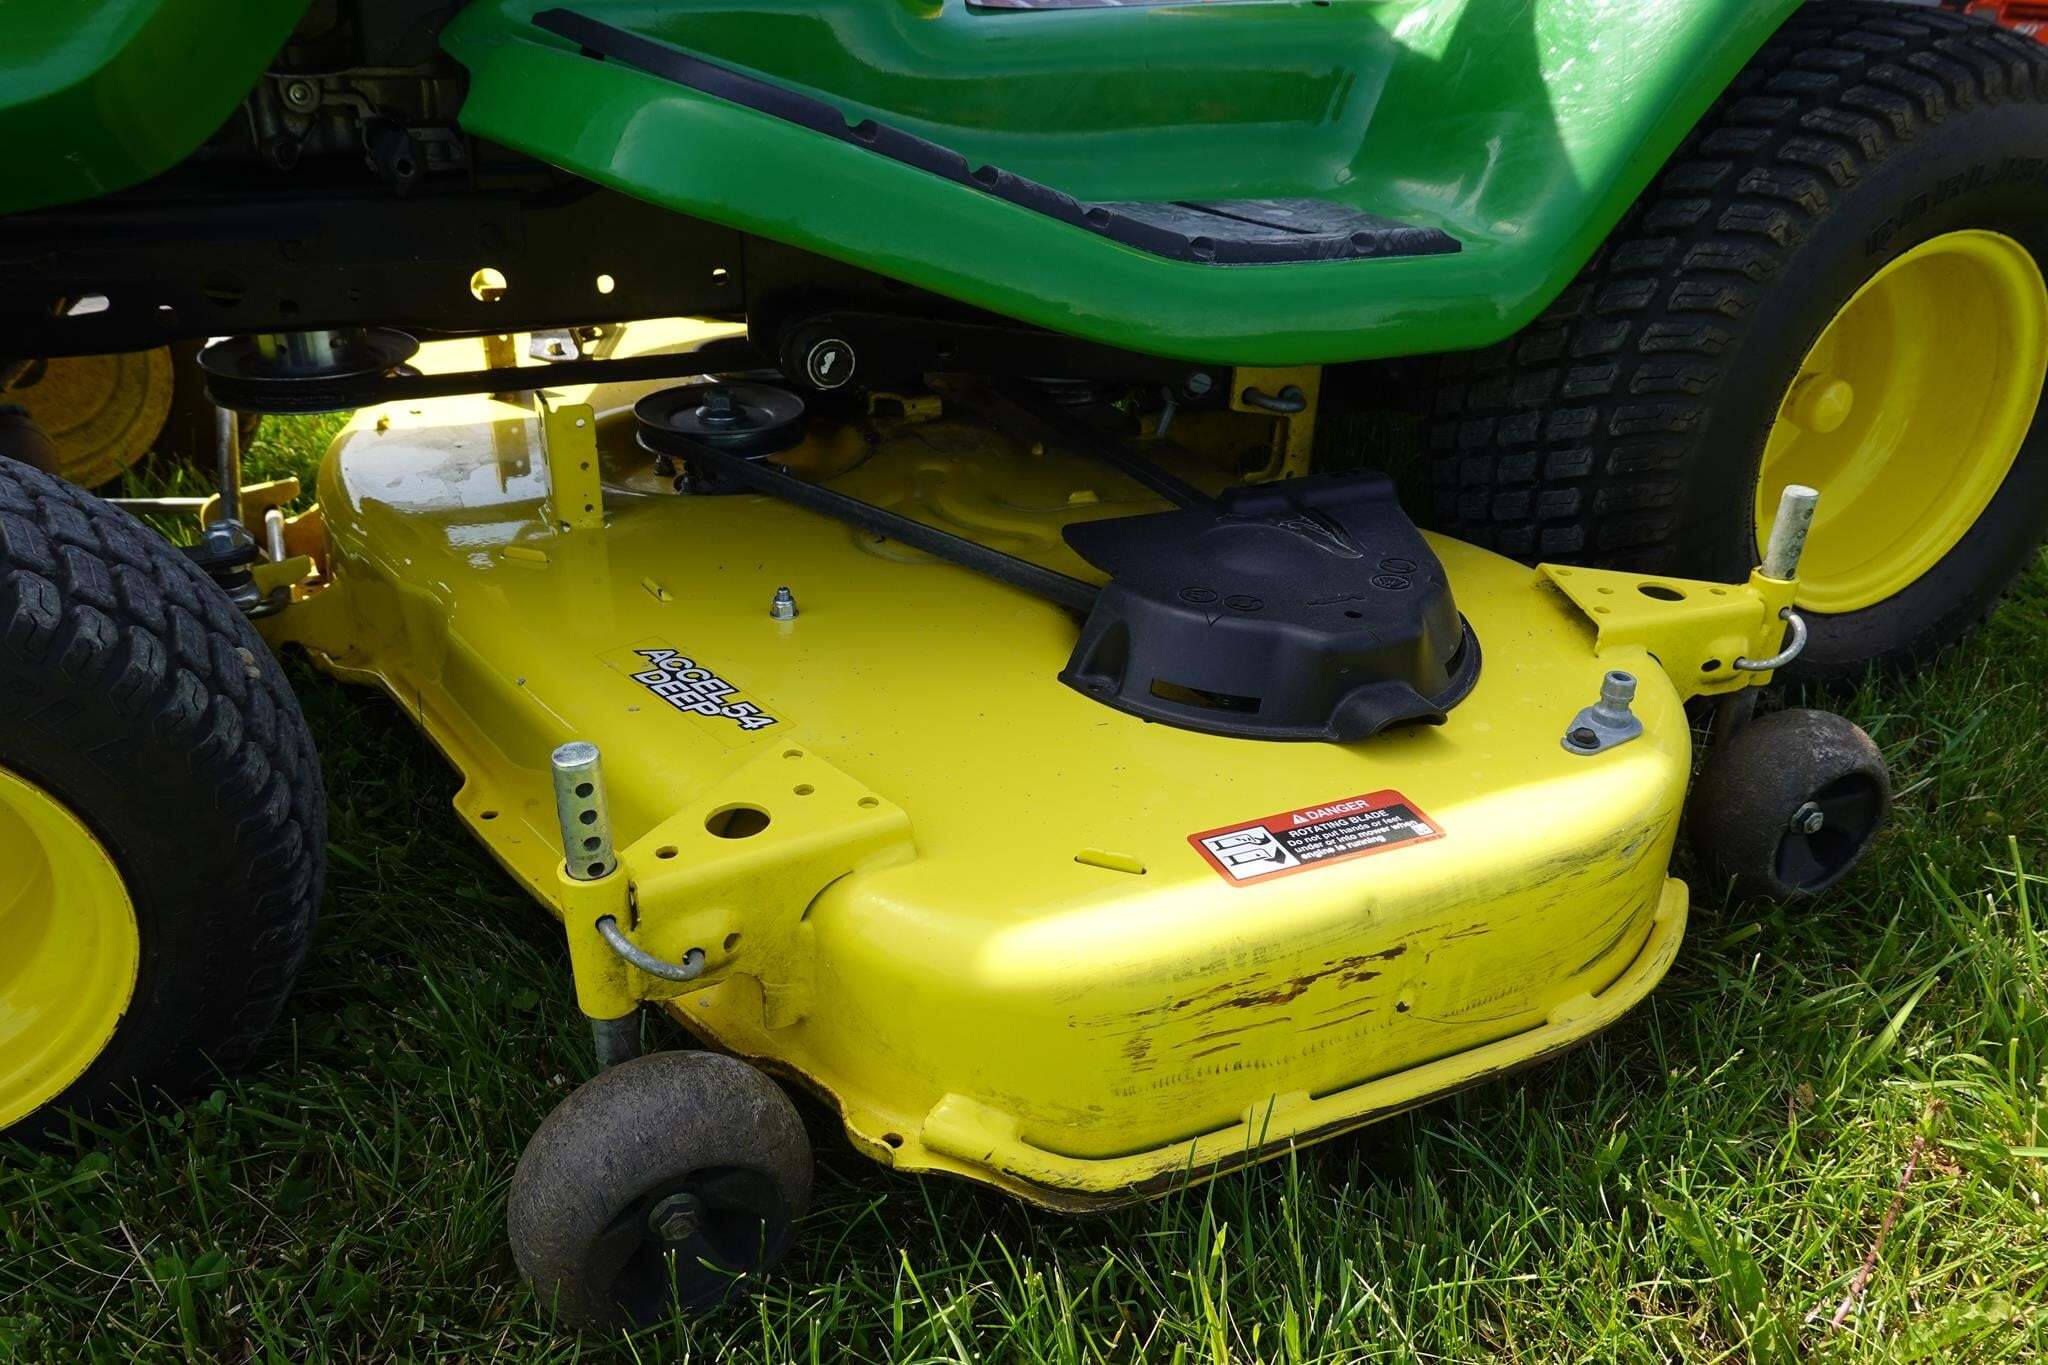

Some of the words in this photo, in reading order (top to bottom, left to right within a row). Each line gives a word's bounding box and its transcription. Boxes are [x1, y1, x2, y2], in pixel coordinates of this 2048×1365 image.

[629, 668, 724, 717] DEEP
[632, 649, 741, 705] ACCEL
[720, 700, 779, 731] 54
[1288, 819, 1348, 838] ROTATING
[1348, 810, 1389, 824] BLADE
[1305, 799, 1370, 820] DANGER
[1287, 839, 1303, 847] Do
[1304, 834, 1322, 843] not
[1322, 830, 1339, 840] put
[1339, 823, 1370, 834] hands
[1382, 815, 1402, 825] feet
[1294, 841, 1324, 853] under
[1336, 833, 1357, 843] into
[1357, 826, 1391, 838] mower
[1390, 820, 1418, 830] when
[1300, 847, 1336, 859] engine
[1346, 835, 1387, 849] running
